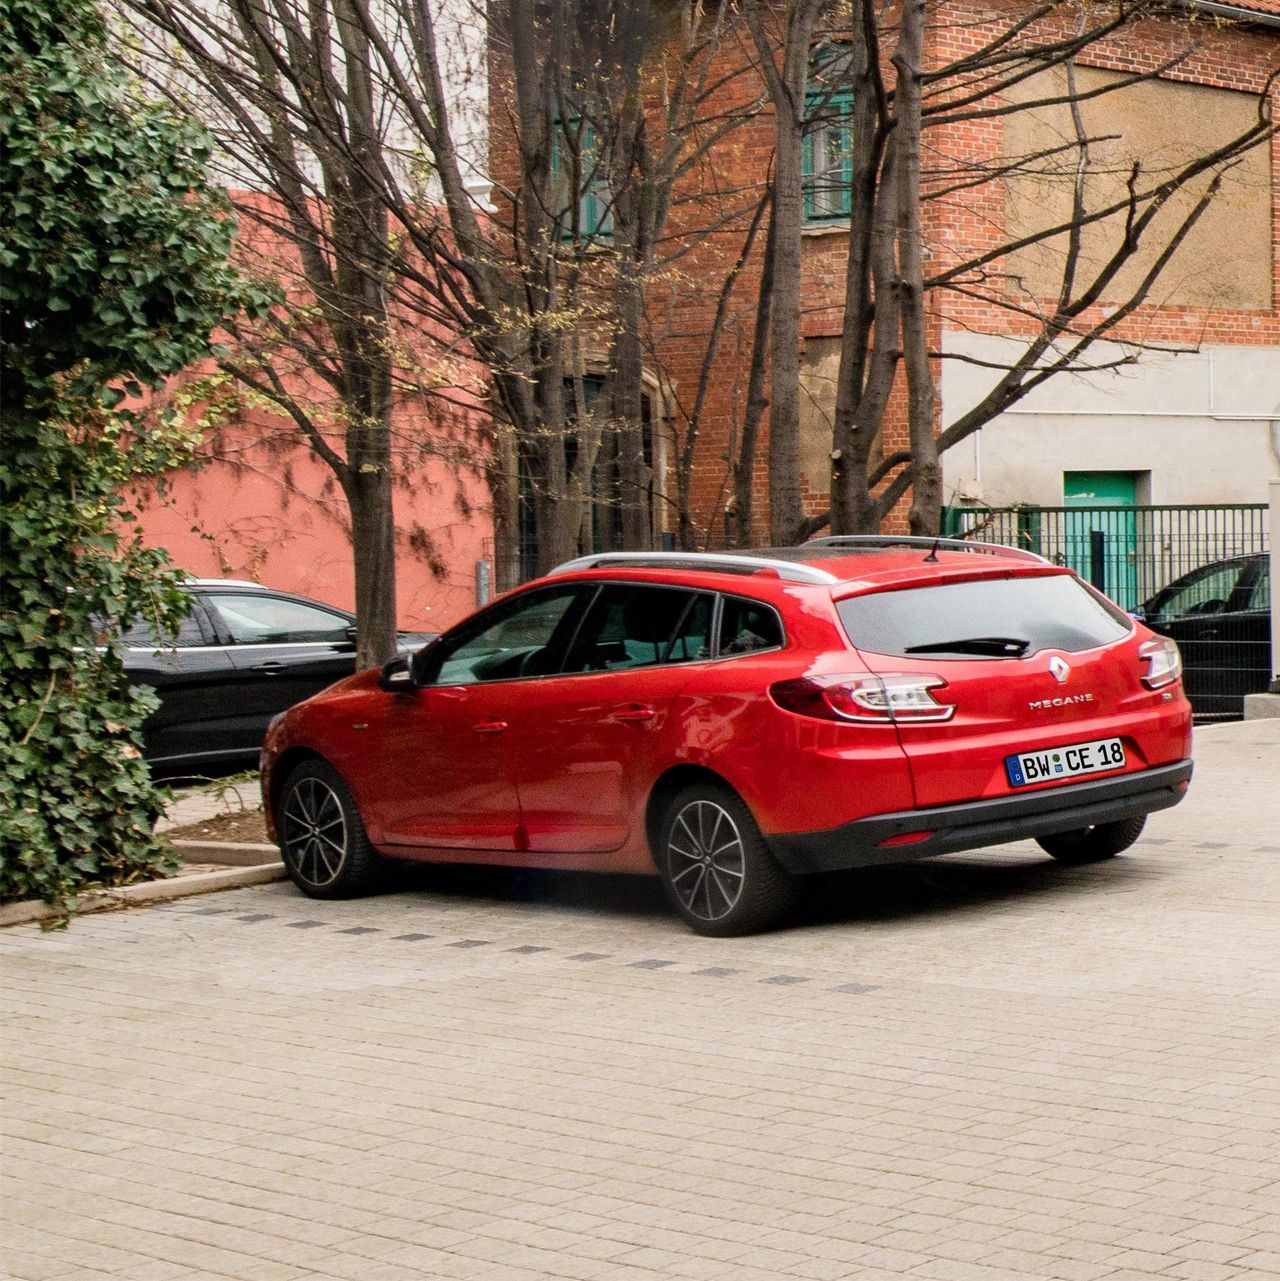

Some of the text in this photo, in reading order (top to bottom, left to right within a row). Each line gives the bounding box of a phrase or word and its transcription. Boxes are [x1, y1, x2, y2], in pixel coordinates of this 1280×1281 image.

[1028, 693, 1095, 710] MEGANE
[1022, 742, 1124, 779] BW CE 18
